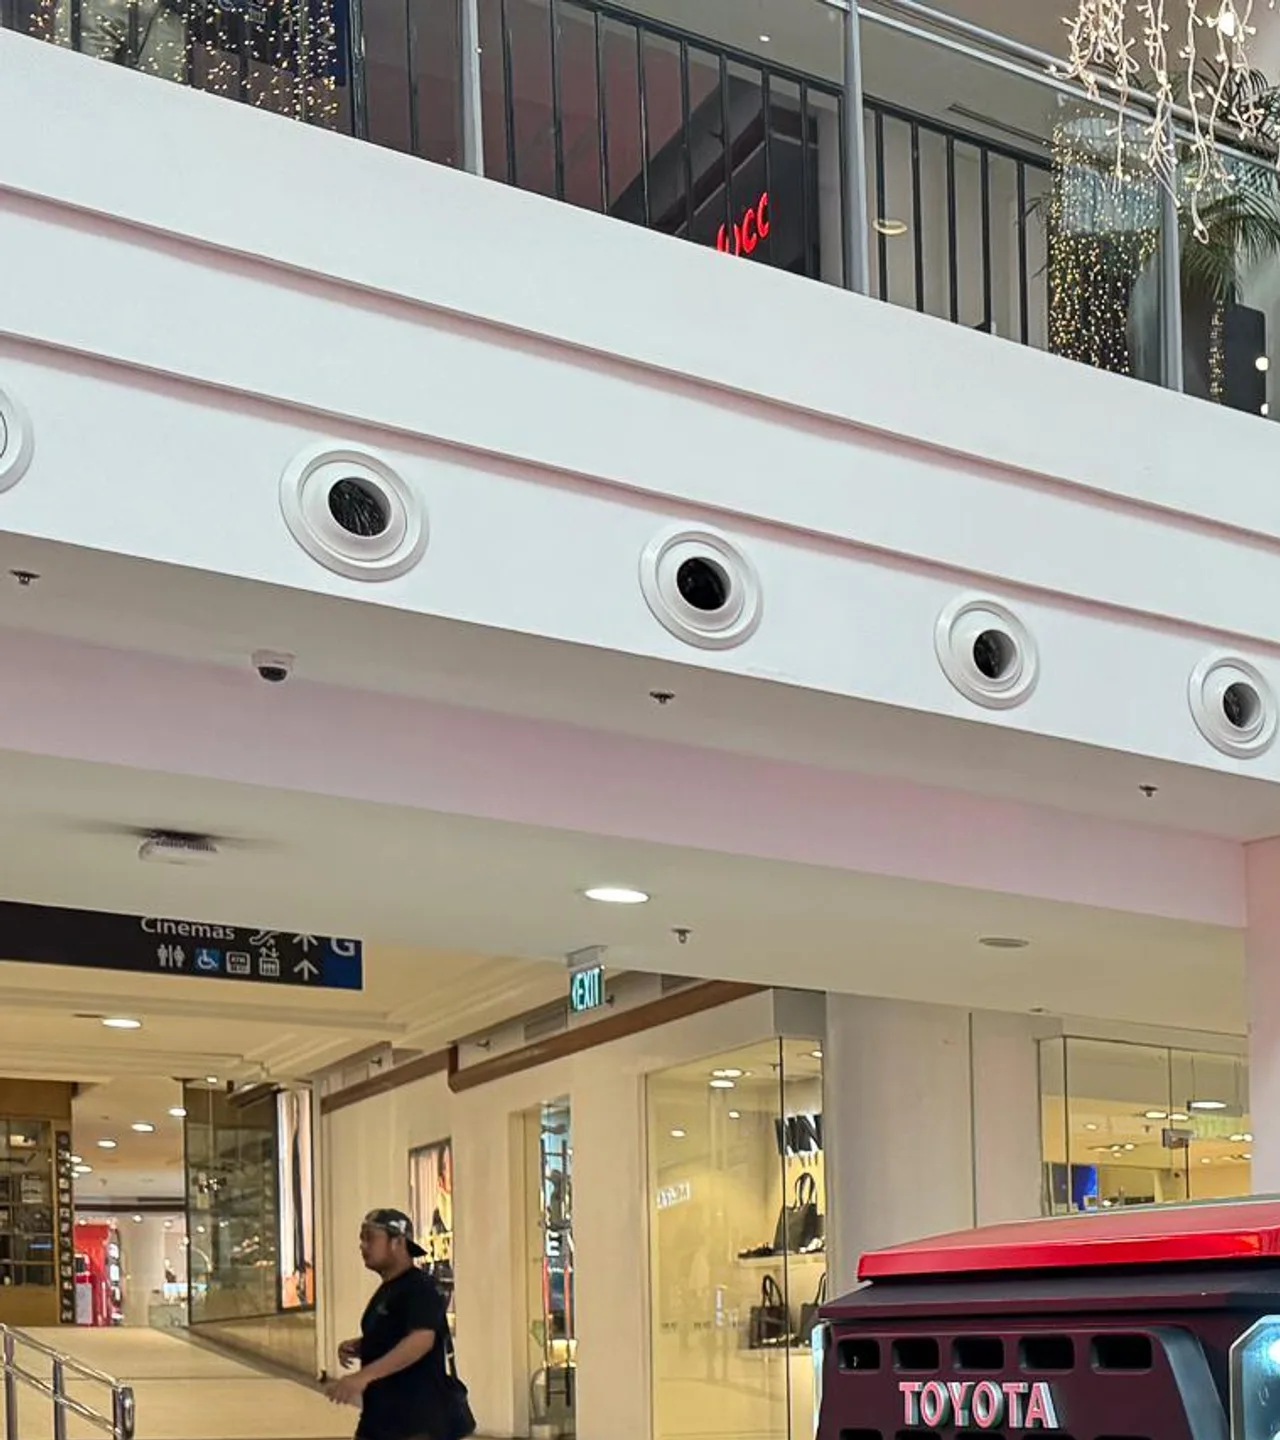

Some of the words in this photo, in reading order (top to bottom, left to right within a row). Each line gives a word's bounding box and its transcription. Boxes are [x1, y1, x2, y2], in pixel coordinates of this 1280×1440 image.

[141, 916, 236, 941] Cinemas
[576, 969, 599, 1010] EXIT
[899, 1380, 1059, 1429] TOYOTA
